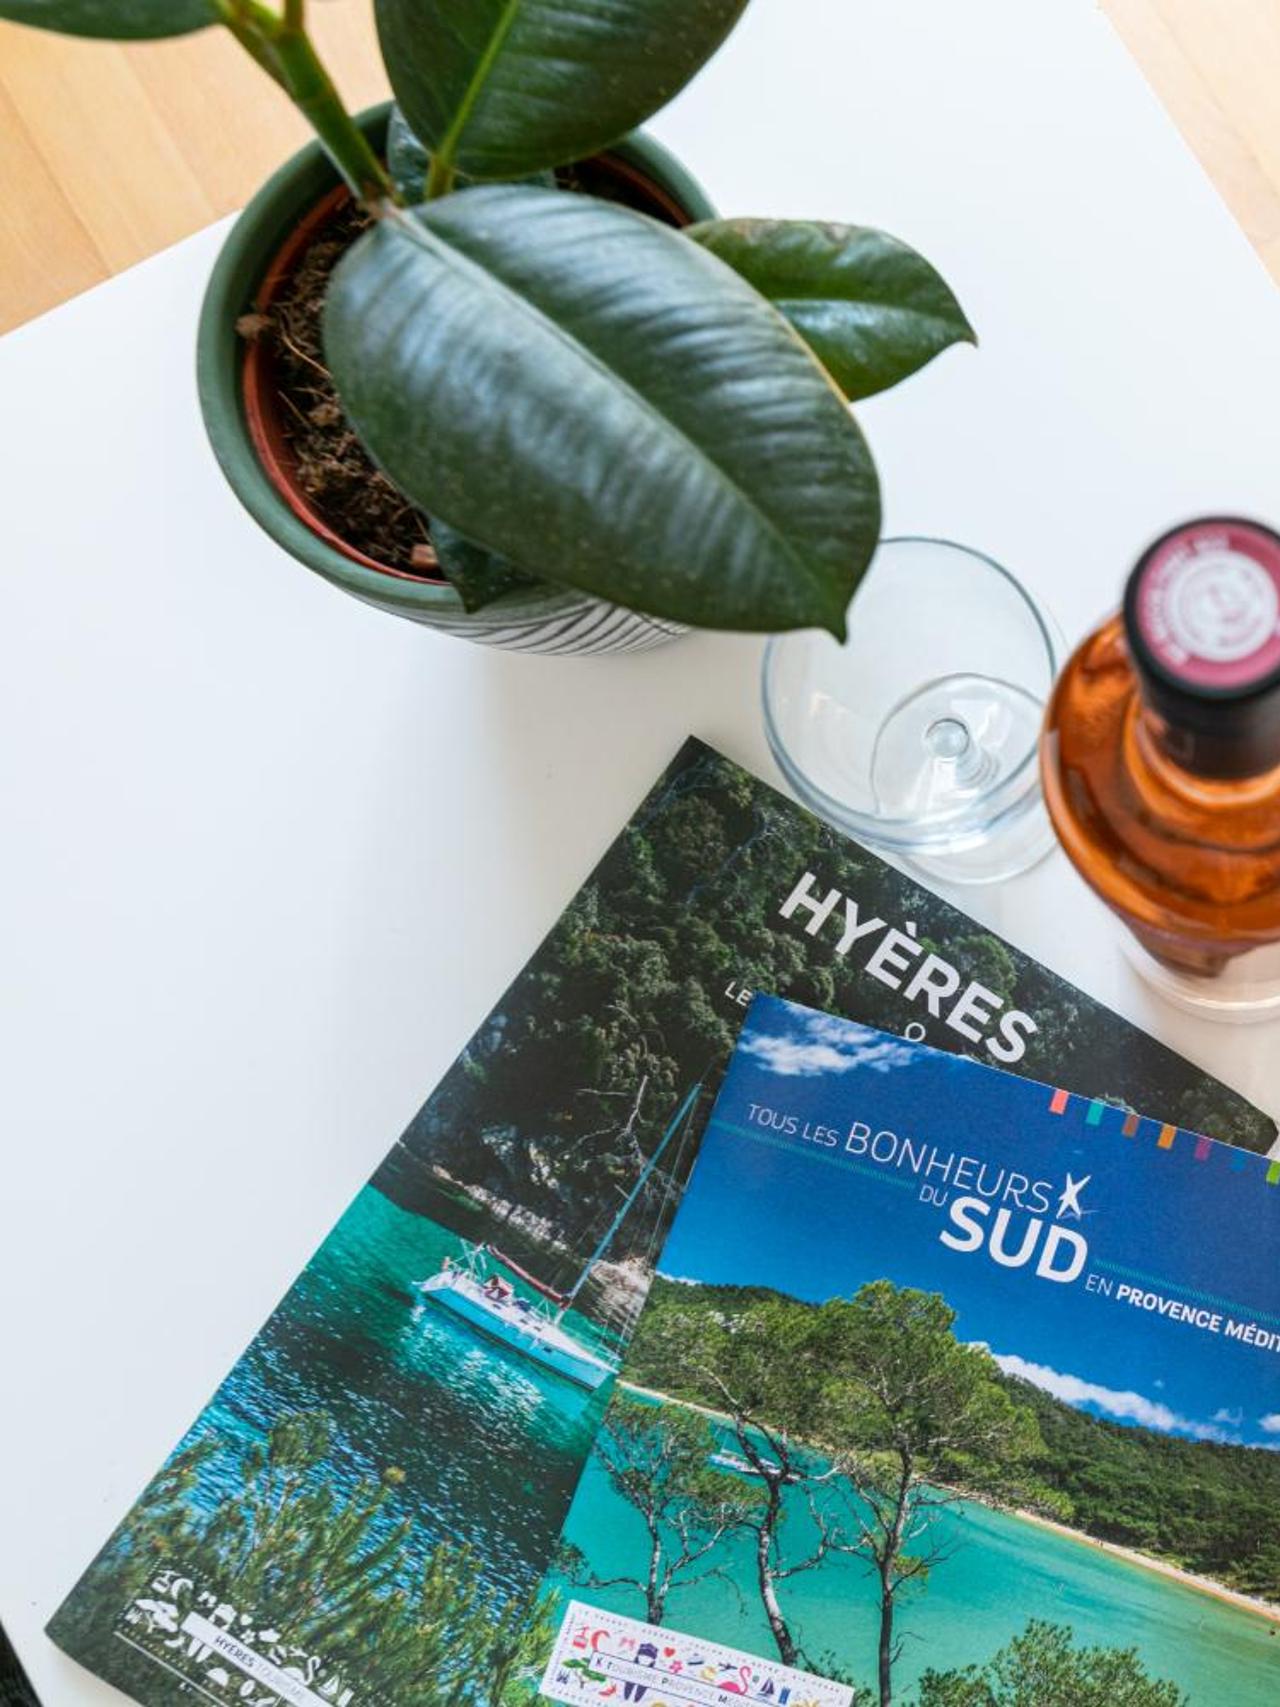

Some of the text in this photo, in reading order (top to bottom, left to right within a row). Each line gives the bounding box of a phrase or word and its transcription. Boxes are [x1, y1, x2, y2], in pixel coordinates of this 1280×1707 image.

[778, 872, 1038, 1063] HYÈRES
[748, 1103, 1053, 1213] TOUS LES BONHEURS
[919, 1184, 1088, 1283] DU SUD
[1085, 1274, 1114, 1297] EN
[1116, 1284, 1224, 1333] PROVENCE
